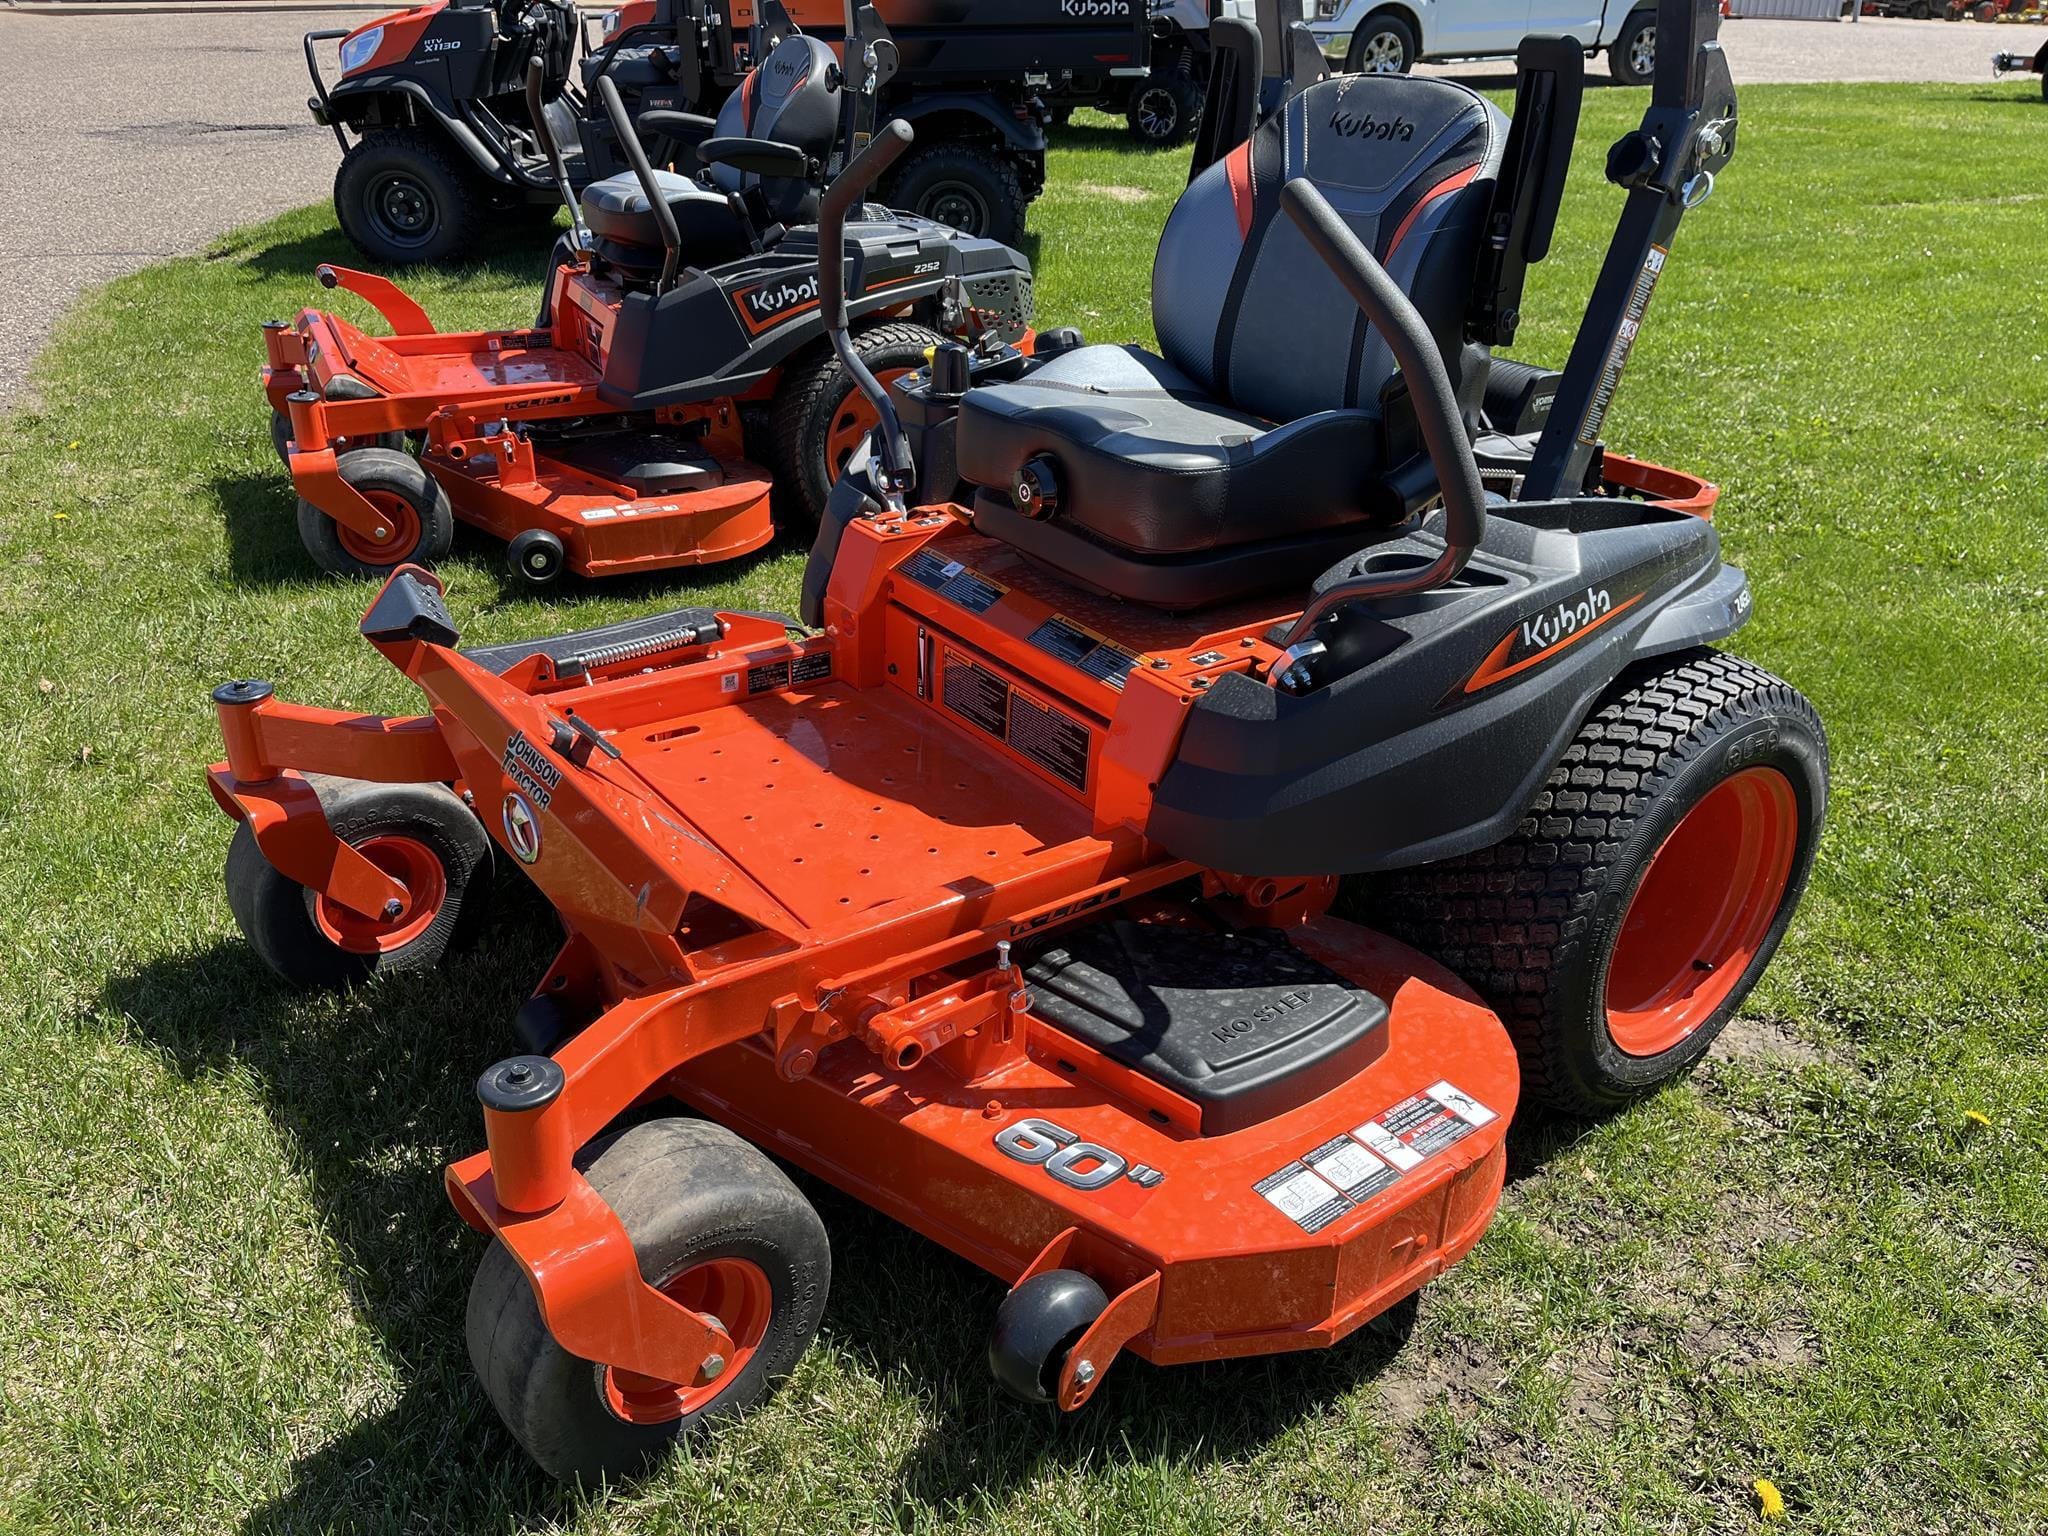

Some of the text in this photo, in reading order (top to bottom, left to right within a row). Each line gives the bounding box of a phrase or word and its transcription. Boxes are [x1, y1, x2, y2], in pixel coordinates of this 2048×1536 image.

[1061, 0, 1130, 16] Kubota
[1328, 111, 1415, 142] Kubota
[913, 261, 940, 274] Z252
[751, 275, 819, 311] Kubot
[1523, 587, 1611, 648] Kubota
[507, 729, 561, 788] JOHNSON
[501, 748, 551, 812] TRACTOR
[1211, 991, 1312, 1045] NO STEP
[1388, 1096, 1419, 1115] DANGER
[1416, 1114, 1447, 1134] PELIGRO
[993, 1117, 1166, 1191] 60"
